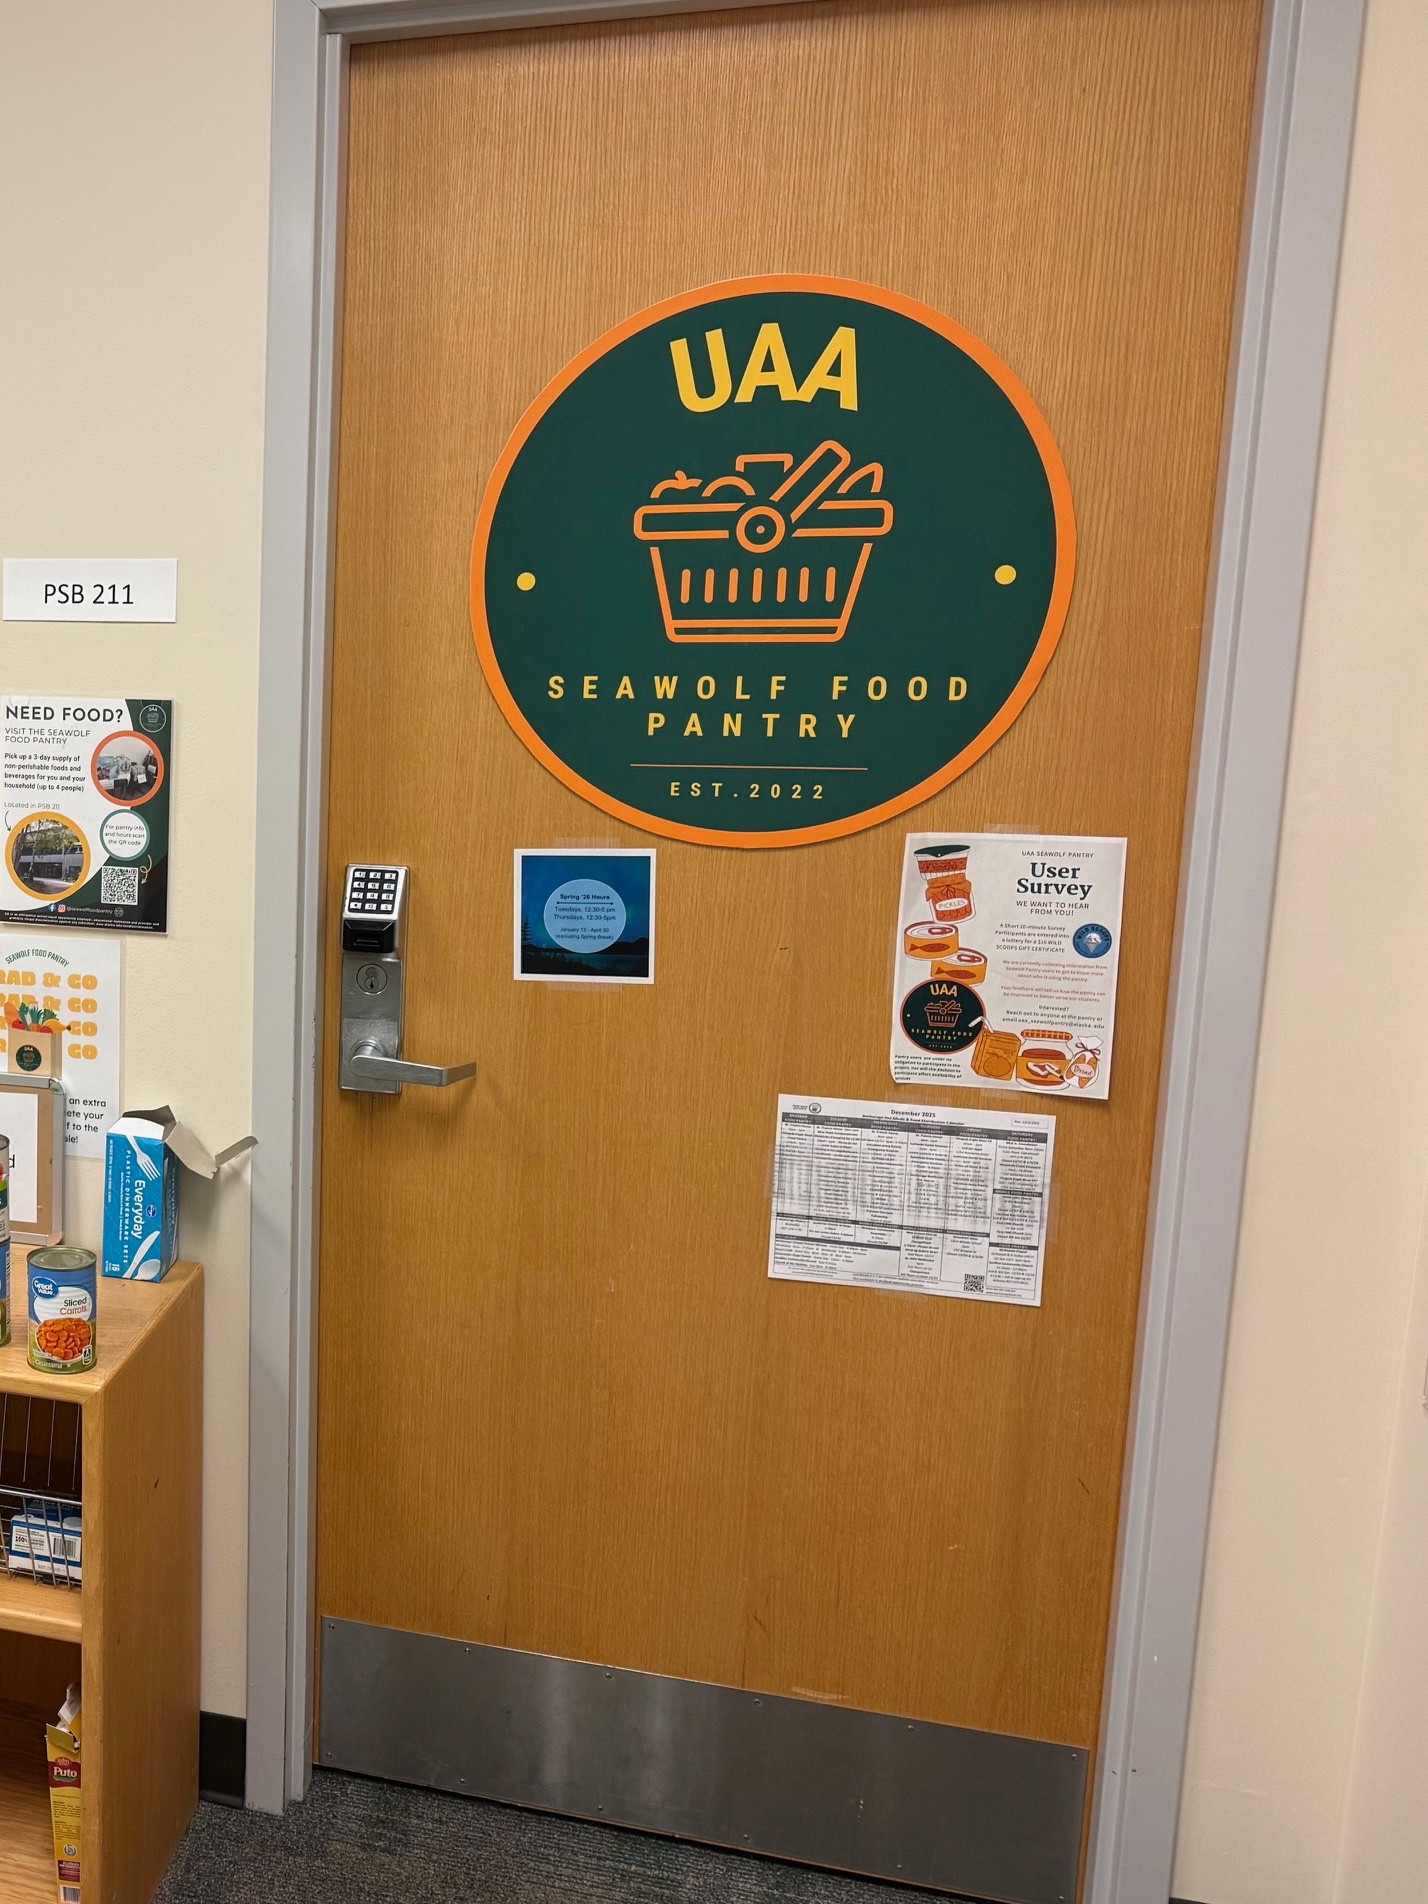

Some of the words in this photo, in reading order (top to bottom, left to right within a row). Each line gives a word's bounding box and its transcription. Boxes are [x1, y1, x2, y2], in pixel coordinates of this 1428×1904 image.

[670, 322, 858, 413] UAA
[44, 584, 84, 604] PSB
[93, 584, 134, 605] 211
[548, 675, 787, 701] SEAWOLF
[831, 676, 968, 702] FOOD
[6, 706, 54, 720] NEED
[63, 708, 123, 722] FOOD?
[48, 729, 90, 737] SEAWOLF
[647, 712, 859, 738] PANTRY
[670, 782, 824, 799] EST.2022
[1030, 862, 1080, 879] User
[1017, 878, 1093, 900] Survey
[5, 949, 30, 964] SEAWOLF
[32, 949, 47, 957] FOOD
[48, 951, 69, 967] PANTRY
[43, 972, 61, 988] &
[68, 974, 98, 990] GO
[930, 984, 957, 997] UAA
[43, 996, 61, 1011] &
[68, 997, 98, 1013] GO
[68, 1020, 98, 1037] GO
[68, 1043, 98, 1060] GO
[83, 1099, 106, 1107] extra
[84, 1112, 104, 1120] your
[891, 1109, 920, 1117] December
[85, 1124, 98, 1132] the
[130, 1180, 146, 1239] Everyday
[112, 1263, 120, 1272] 16
[34, 1281, 53, 1290] Great
[60, 1305, 87, 1315] Carrots
[64, 1297, 87, 1307] Sliced
[53, 1766, 78, 1779] Puto
